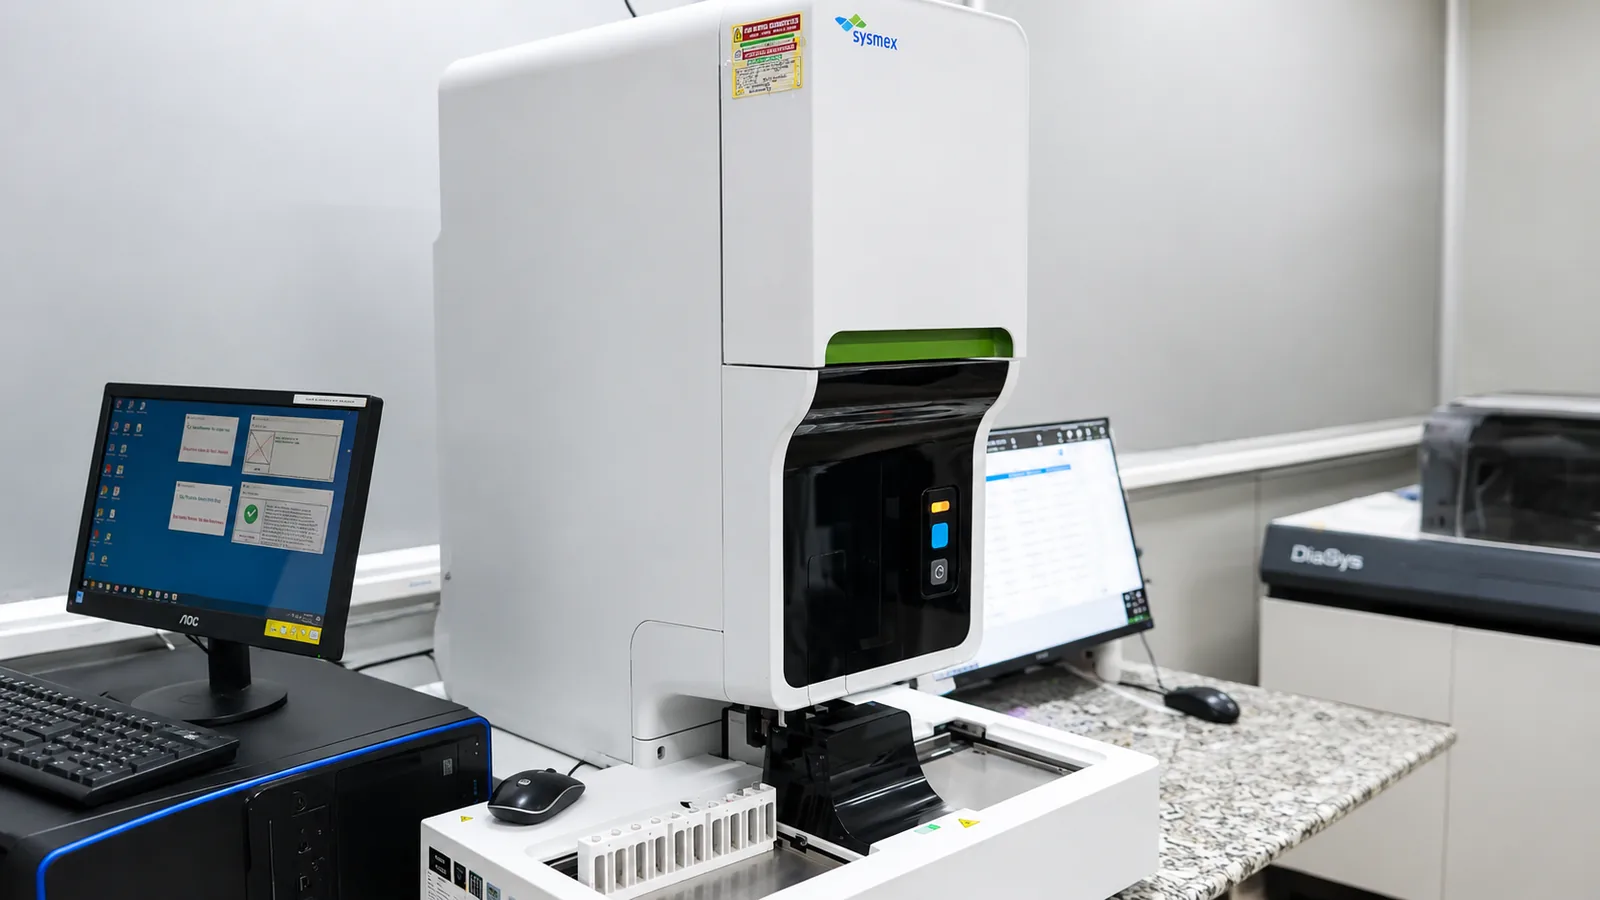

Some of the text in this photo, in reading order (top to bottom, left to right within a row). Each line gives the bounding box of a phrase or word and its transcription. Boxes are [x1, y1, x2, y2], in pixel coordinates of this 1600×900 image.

[853, 30, 898, 50] sysmex
[1290, 544, 1364, 572] DiaSys
[179, 614, 200, 627] AOC
